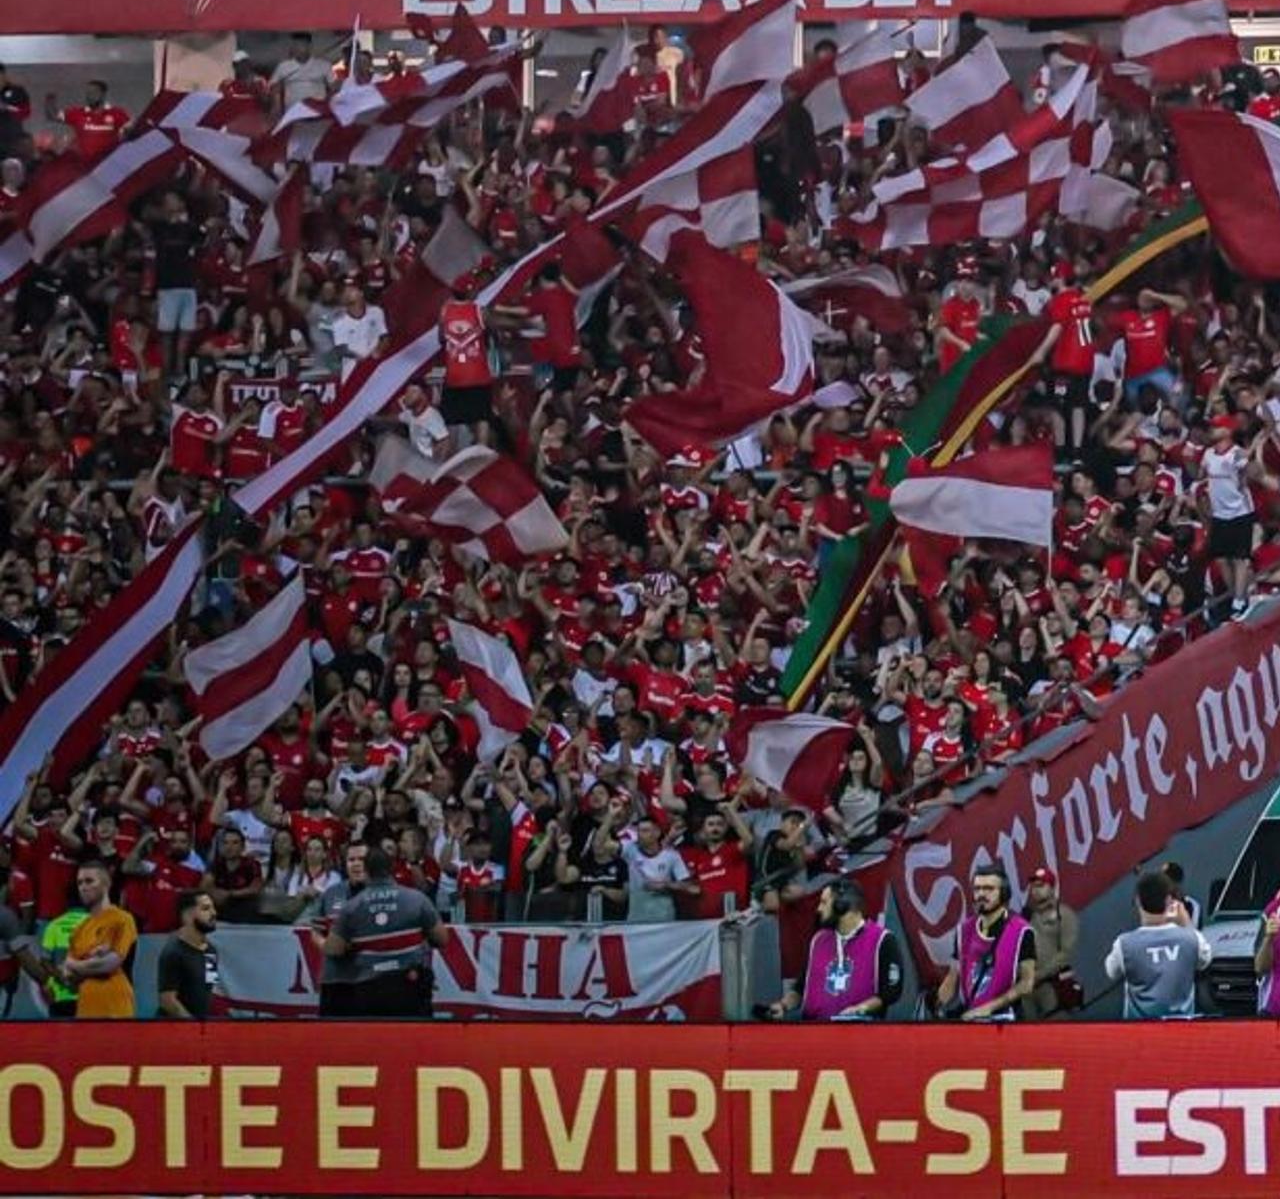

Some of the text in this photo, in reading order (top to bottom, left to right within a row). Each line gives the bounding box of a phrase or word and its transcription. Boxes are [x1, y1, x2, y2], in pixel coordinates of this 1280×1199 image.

[290, 928, 638, 999] NHA
[1146, 944, 1180, 964] TV
[317, 1065, 379, 1170] E
[416, 1065, 1070, 1176] DIVIRTA-SE
